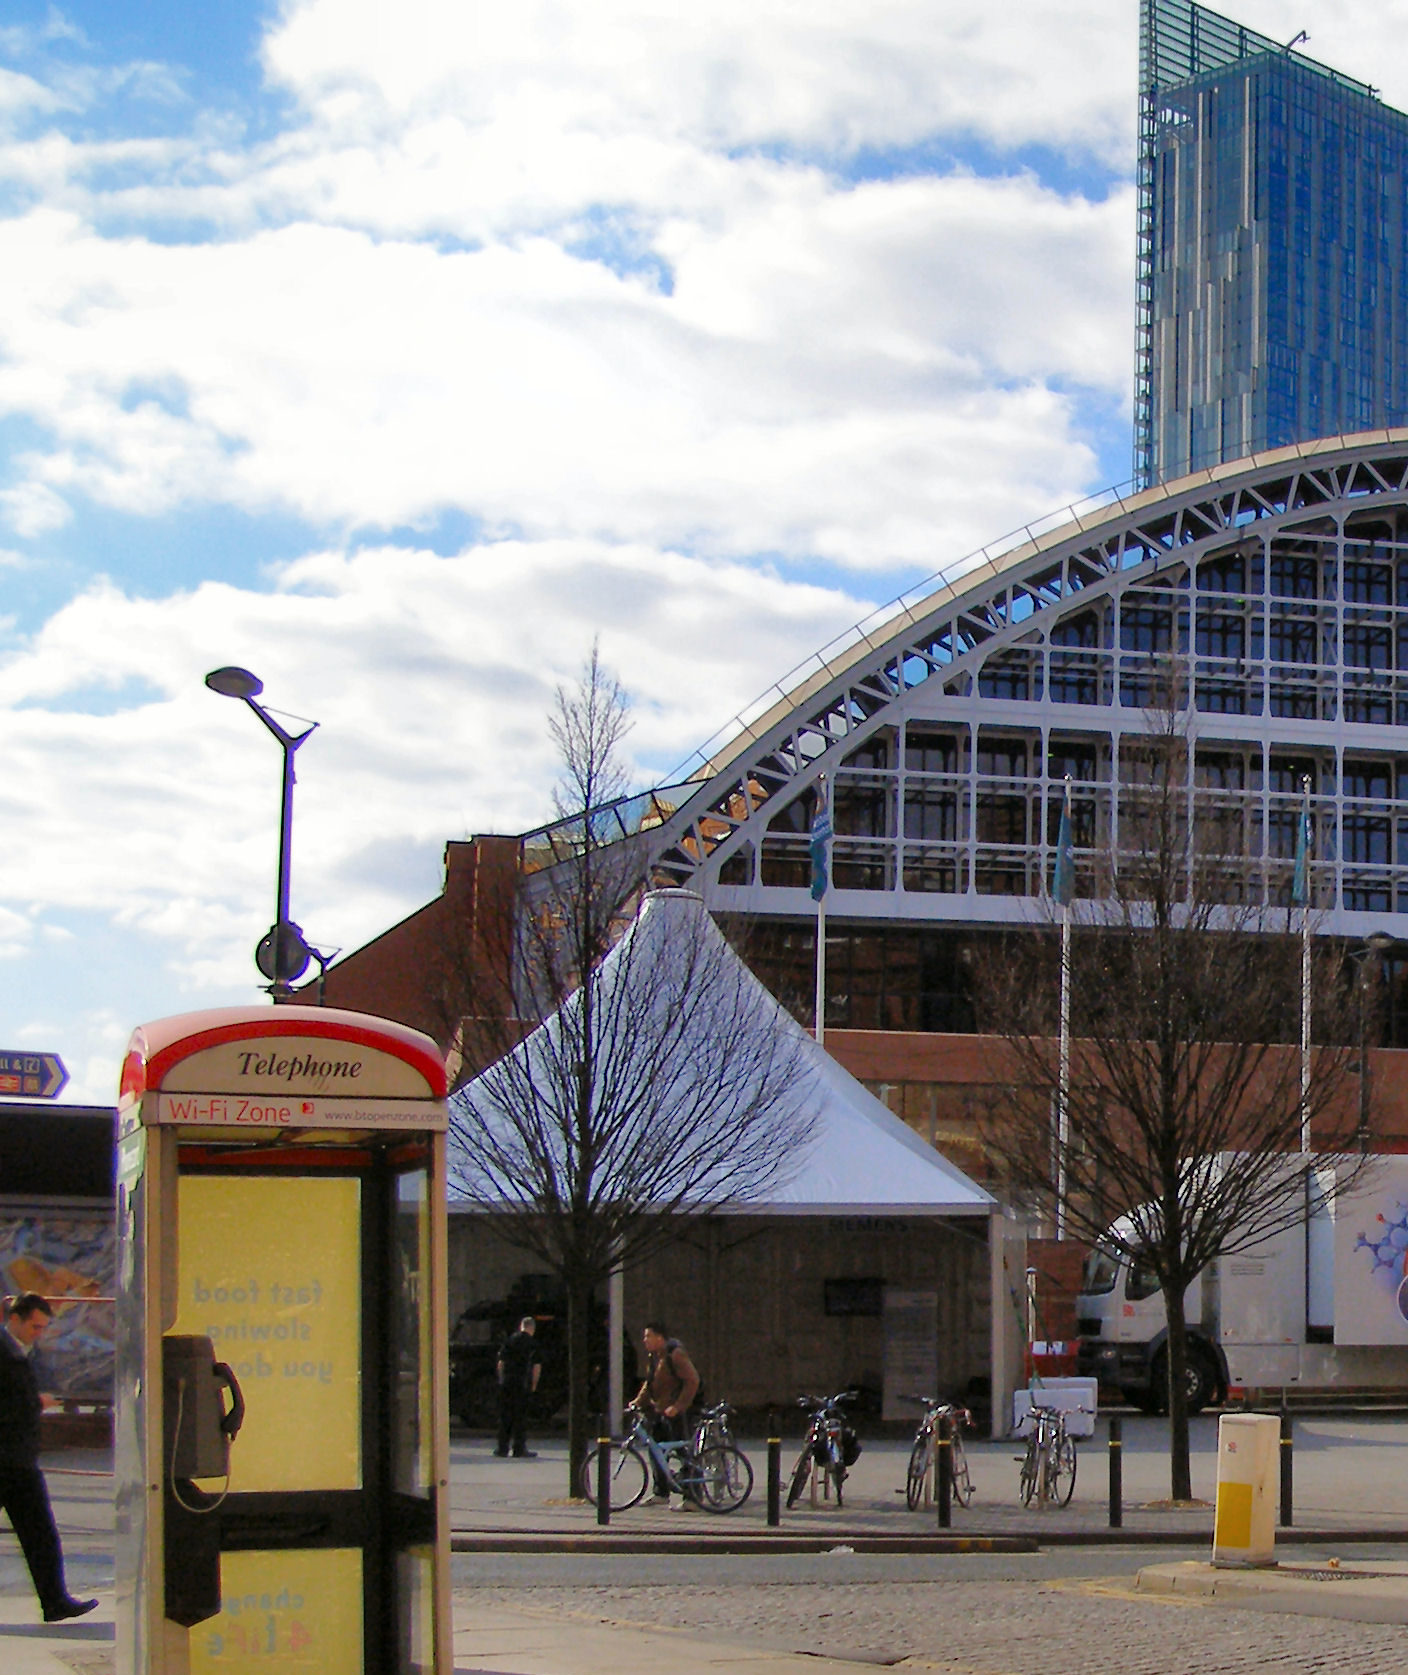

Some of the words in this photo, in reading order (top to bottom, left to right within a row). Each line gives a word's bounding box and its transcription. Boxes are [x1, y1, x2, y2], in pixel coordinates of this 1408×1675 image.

[237, 1052, 363, 1081] Telephone
[168, 1098, 228, 1121] Wi-Fi
[236, 1100, 292, 1123] Zone
[324, 1109, 444, 1123] www.btopenzone.com
